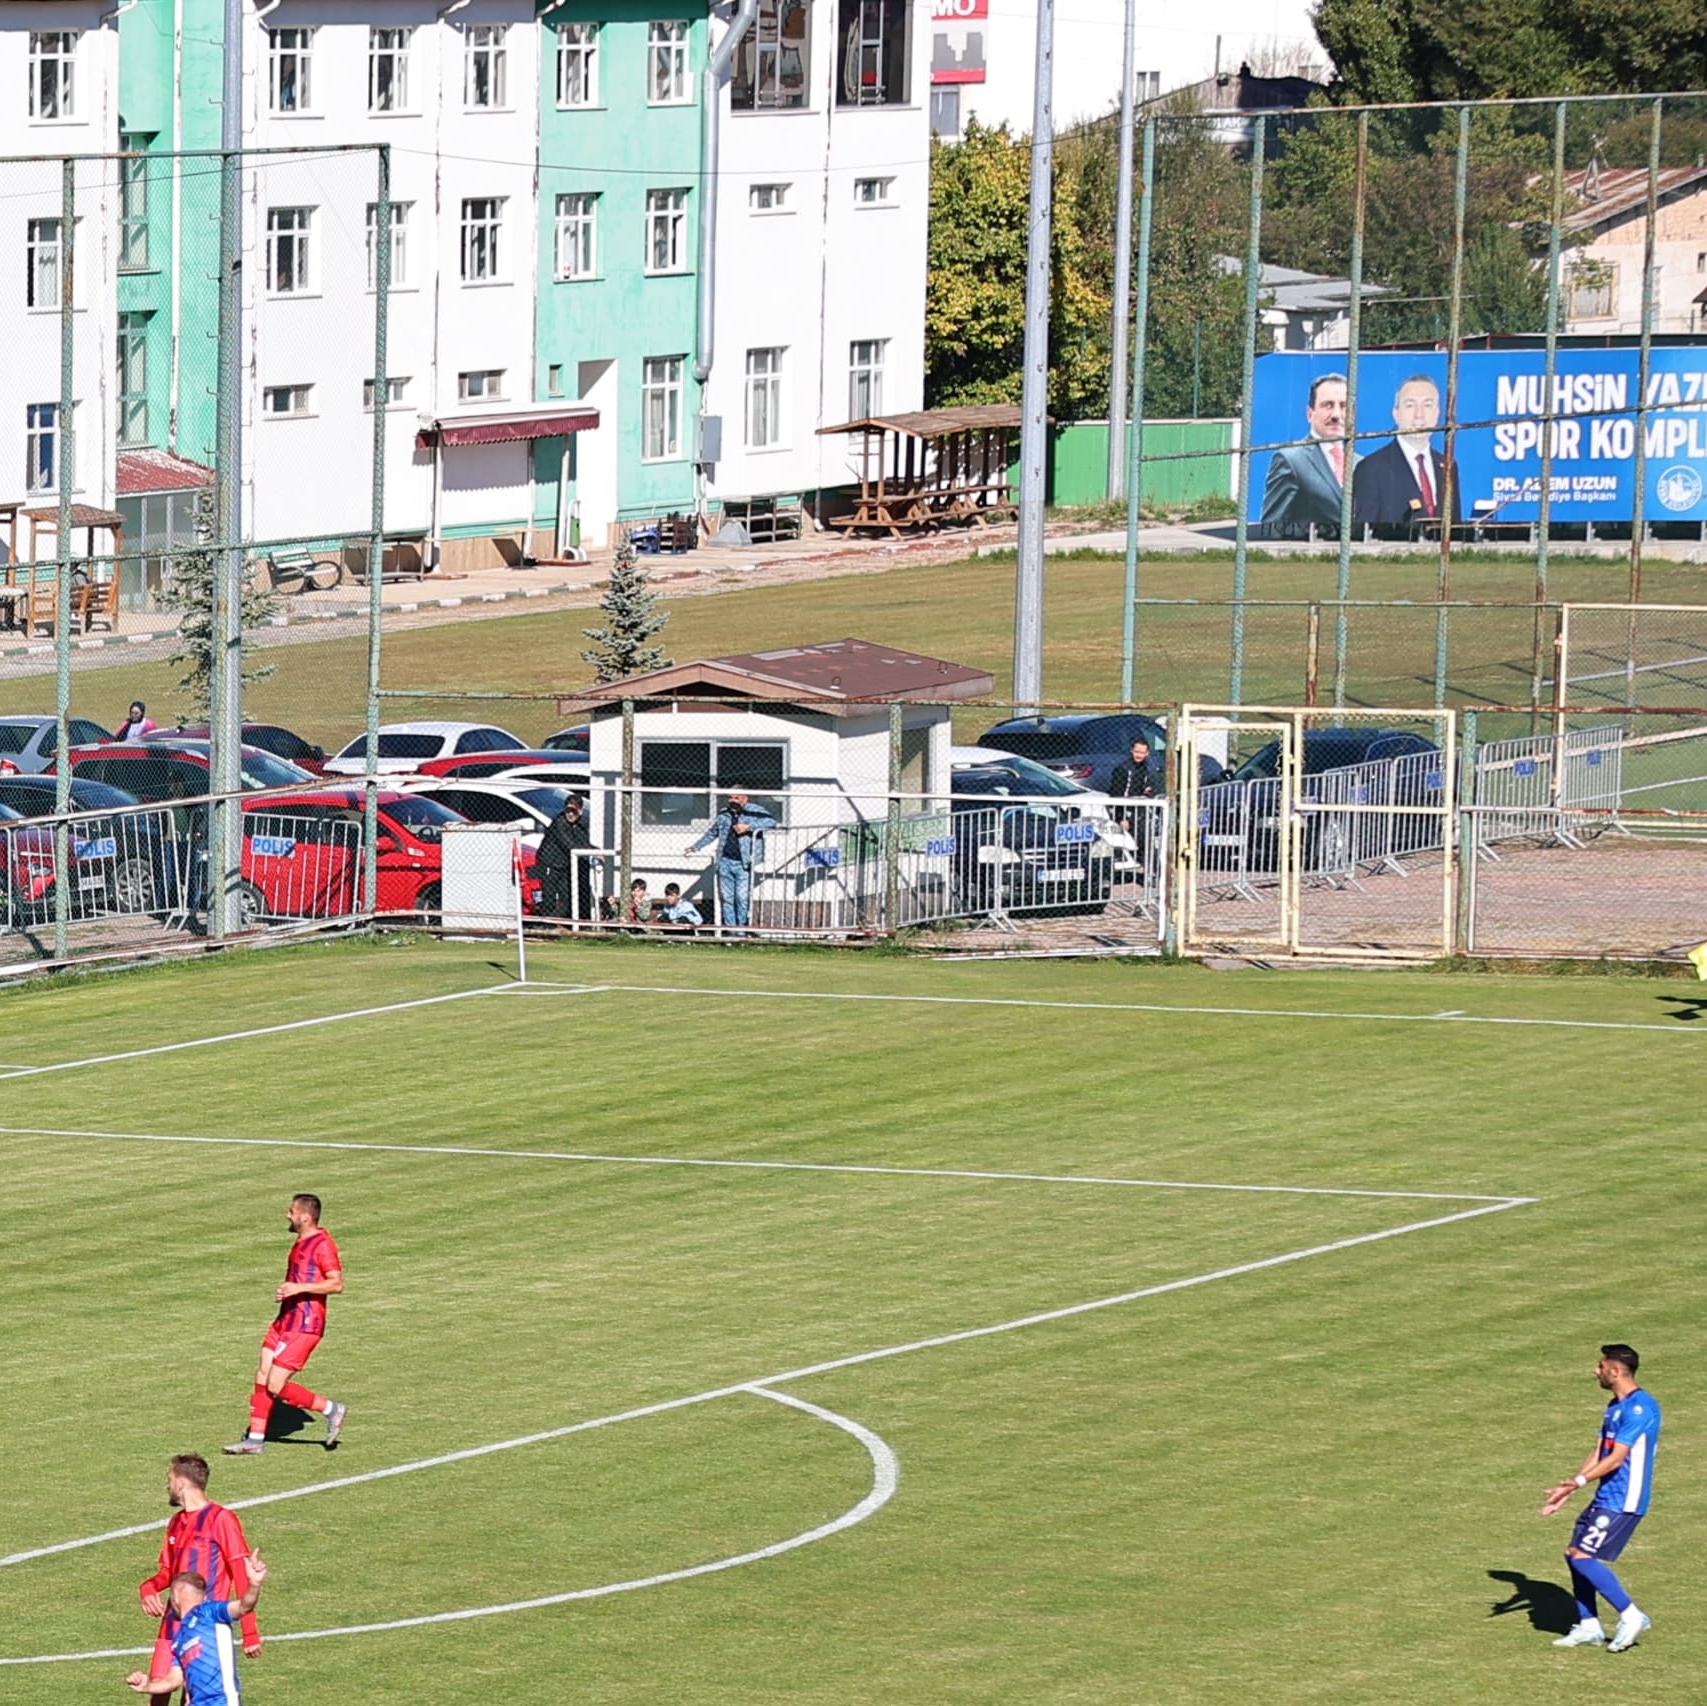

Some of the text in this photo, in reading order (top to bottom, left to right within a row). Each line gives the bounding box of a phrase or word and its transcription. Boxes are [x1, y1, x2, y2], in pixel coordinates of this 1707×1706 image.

[1494, 419, 1581, 460] SPOR
[1493, 477, 1519, 491] DR.
[1572, 475, 1617, 490] UZUN
[1582, 1525, 1607, 1549] 21
